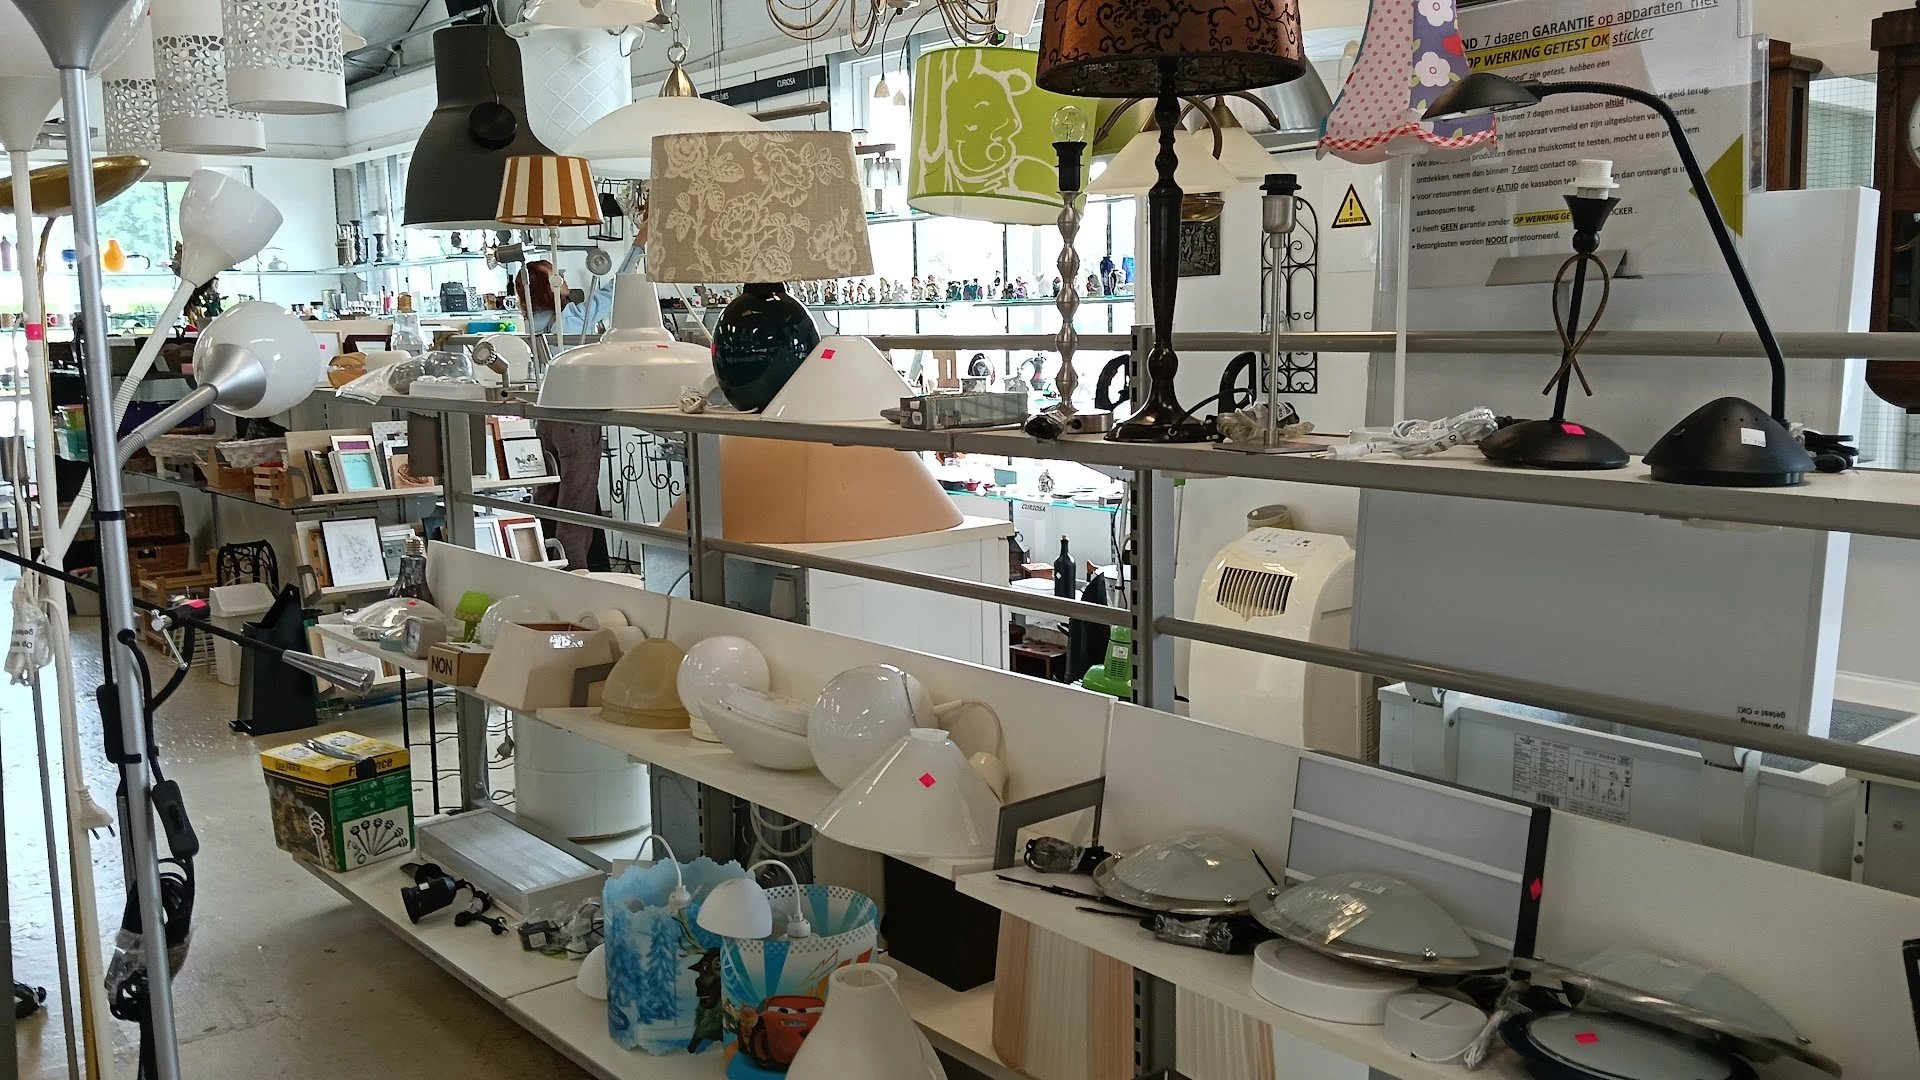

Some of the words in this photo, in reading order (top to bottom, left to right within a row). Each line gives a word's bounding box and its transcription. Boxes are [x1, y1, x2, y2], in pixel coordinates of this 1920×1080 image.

[1461, 38, 1478, 50] ND
[1484, 35, 1491, 47] 7
[1494, 30, 1529, 44] dagen
[1532, 15, 1595, 37] GARANTIE
[1598, 14, 1613, 27] op
[1617, 1, 1683, 23] apparaten
[1484, 45, 1540, 67] WERKING
[1544, 37, 1589, 56] GETEST
[1591, 33, 1610, 47] OK
[1612, 27, 1654, 44] sticker
[1542, 67, 1565, 78] getest,
[1569, 63, 1595, 73] hebben
[1597, 60, 1610, 69] een
[777, 77, 796, 88] CURIOSA
[1502, 112, 1525, 122] binnen
[1532, 109, 1553, 119] dagen
[1555, 106, 1569, 115] met
[1570, 101, 1604, 112] kassabon
[1605, 97, 1624, 108] altijd
[1669, 90, 1685, 100] geld
[1687, 87, 1711, 97] terug.
[1517, 128, 1548, 139] apparaat
[1549, 122, 1578, 133] vermeld
[1590, 119, 1603, 130] zijn
[1604, 114, 1646, 127] uitgesloten
[1506, 147, 1526, 157] direct
[1538, 141, 1576, 153] thuiskomst
[1586, 137, 1611, 147] testen,
[1613, 132, 1637, 143] mocht
[1645, 130, 1660, 139] een
[1416, 174, 1451, 184] ontdekken,
[1472, 170, 1485, 178] dan
[1486, 167, 1509, 176] binnen
[1512, 165, 1516, 174] 7
[1517, 163, 1538, 174] dagen
[1539, 160, 1566, 170] contact
[1567, 160, 1579, 168] op.
[1416, 192, 1432, 201] Voor
[1432, 189, 1471, 199] retourneren
[1472, 185, 1489, 195] dient
[1496, 182, 1519, 194] ALTIJD
[1520, 181, 1529, 189] de
[1530, 178, 1562, 189] kassabon
[1621, 170, 1636, 179] dan
[1636, 166, 1671, 177] ontvangt
[1416, 207, 1456, 217] aankoopsom
[1457, 204, 1477, 214] terug.
[1416, 225, 1422, 233] U
[1422, 223, 1440, 232] heeft
[1440, 222, 1459, 233] GEEN
[1459, 219, 1486, 230] garantie
[1487, 218, 1510, 227] zonder
[1513, 215, 1524, 224] OP
[1525, 213, 1559, 223] WERKING
[1416, 239, 1459, 250] Bezorgkosten
[1459, 237, 1484, 247] worden
[1485, 235, 1508, 246] NOOIT
[1509, 231, 1560, 244] geretourneerd.
[1021, 503, 1046, 513] CURIOSA
[431, 655, 453, 677] NON
[1761, 710, 1786, 719] getest
